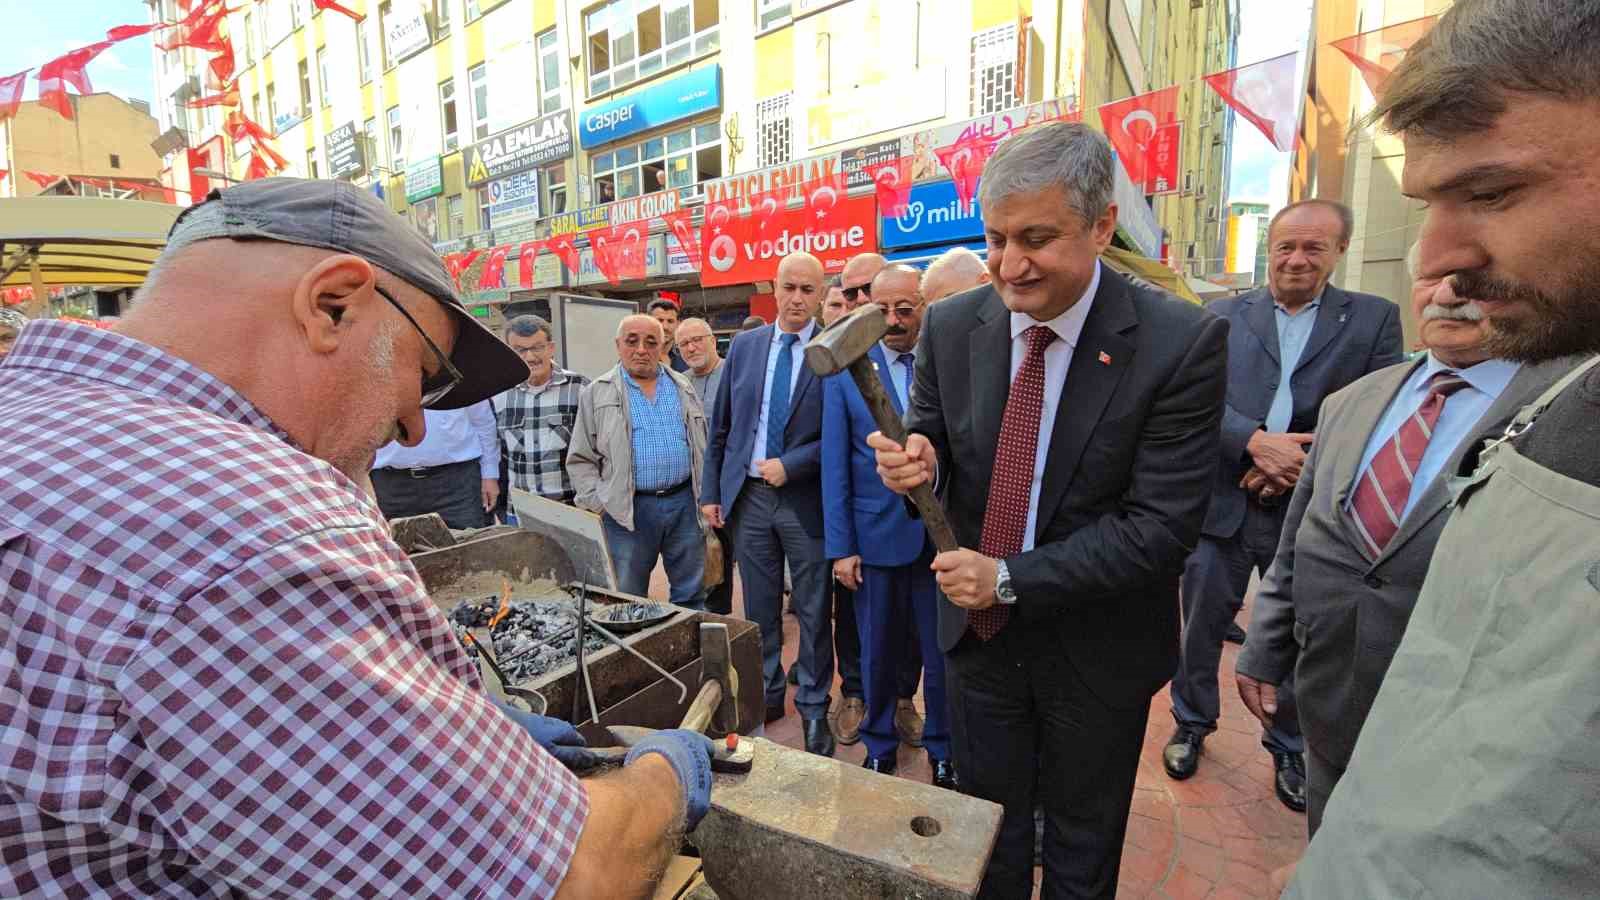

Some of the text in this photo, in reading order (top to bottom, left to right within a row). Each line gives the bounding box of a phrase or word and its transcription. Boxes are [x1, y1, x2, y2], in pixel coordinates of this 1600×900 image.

[586, 103, 634, 131] Casper
[482, 137, 504, 161] 2A
[505, 111, 567, 153] EMLAK
[768, 158, 838, 207] EMLAK
[551, 210, 579, 235] SARAL
[611, 191, 677, 226] AKIN COLOR
[743, 225, 864, 260] vodafone
